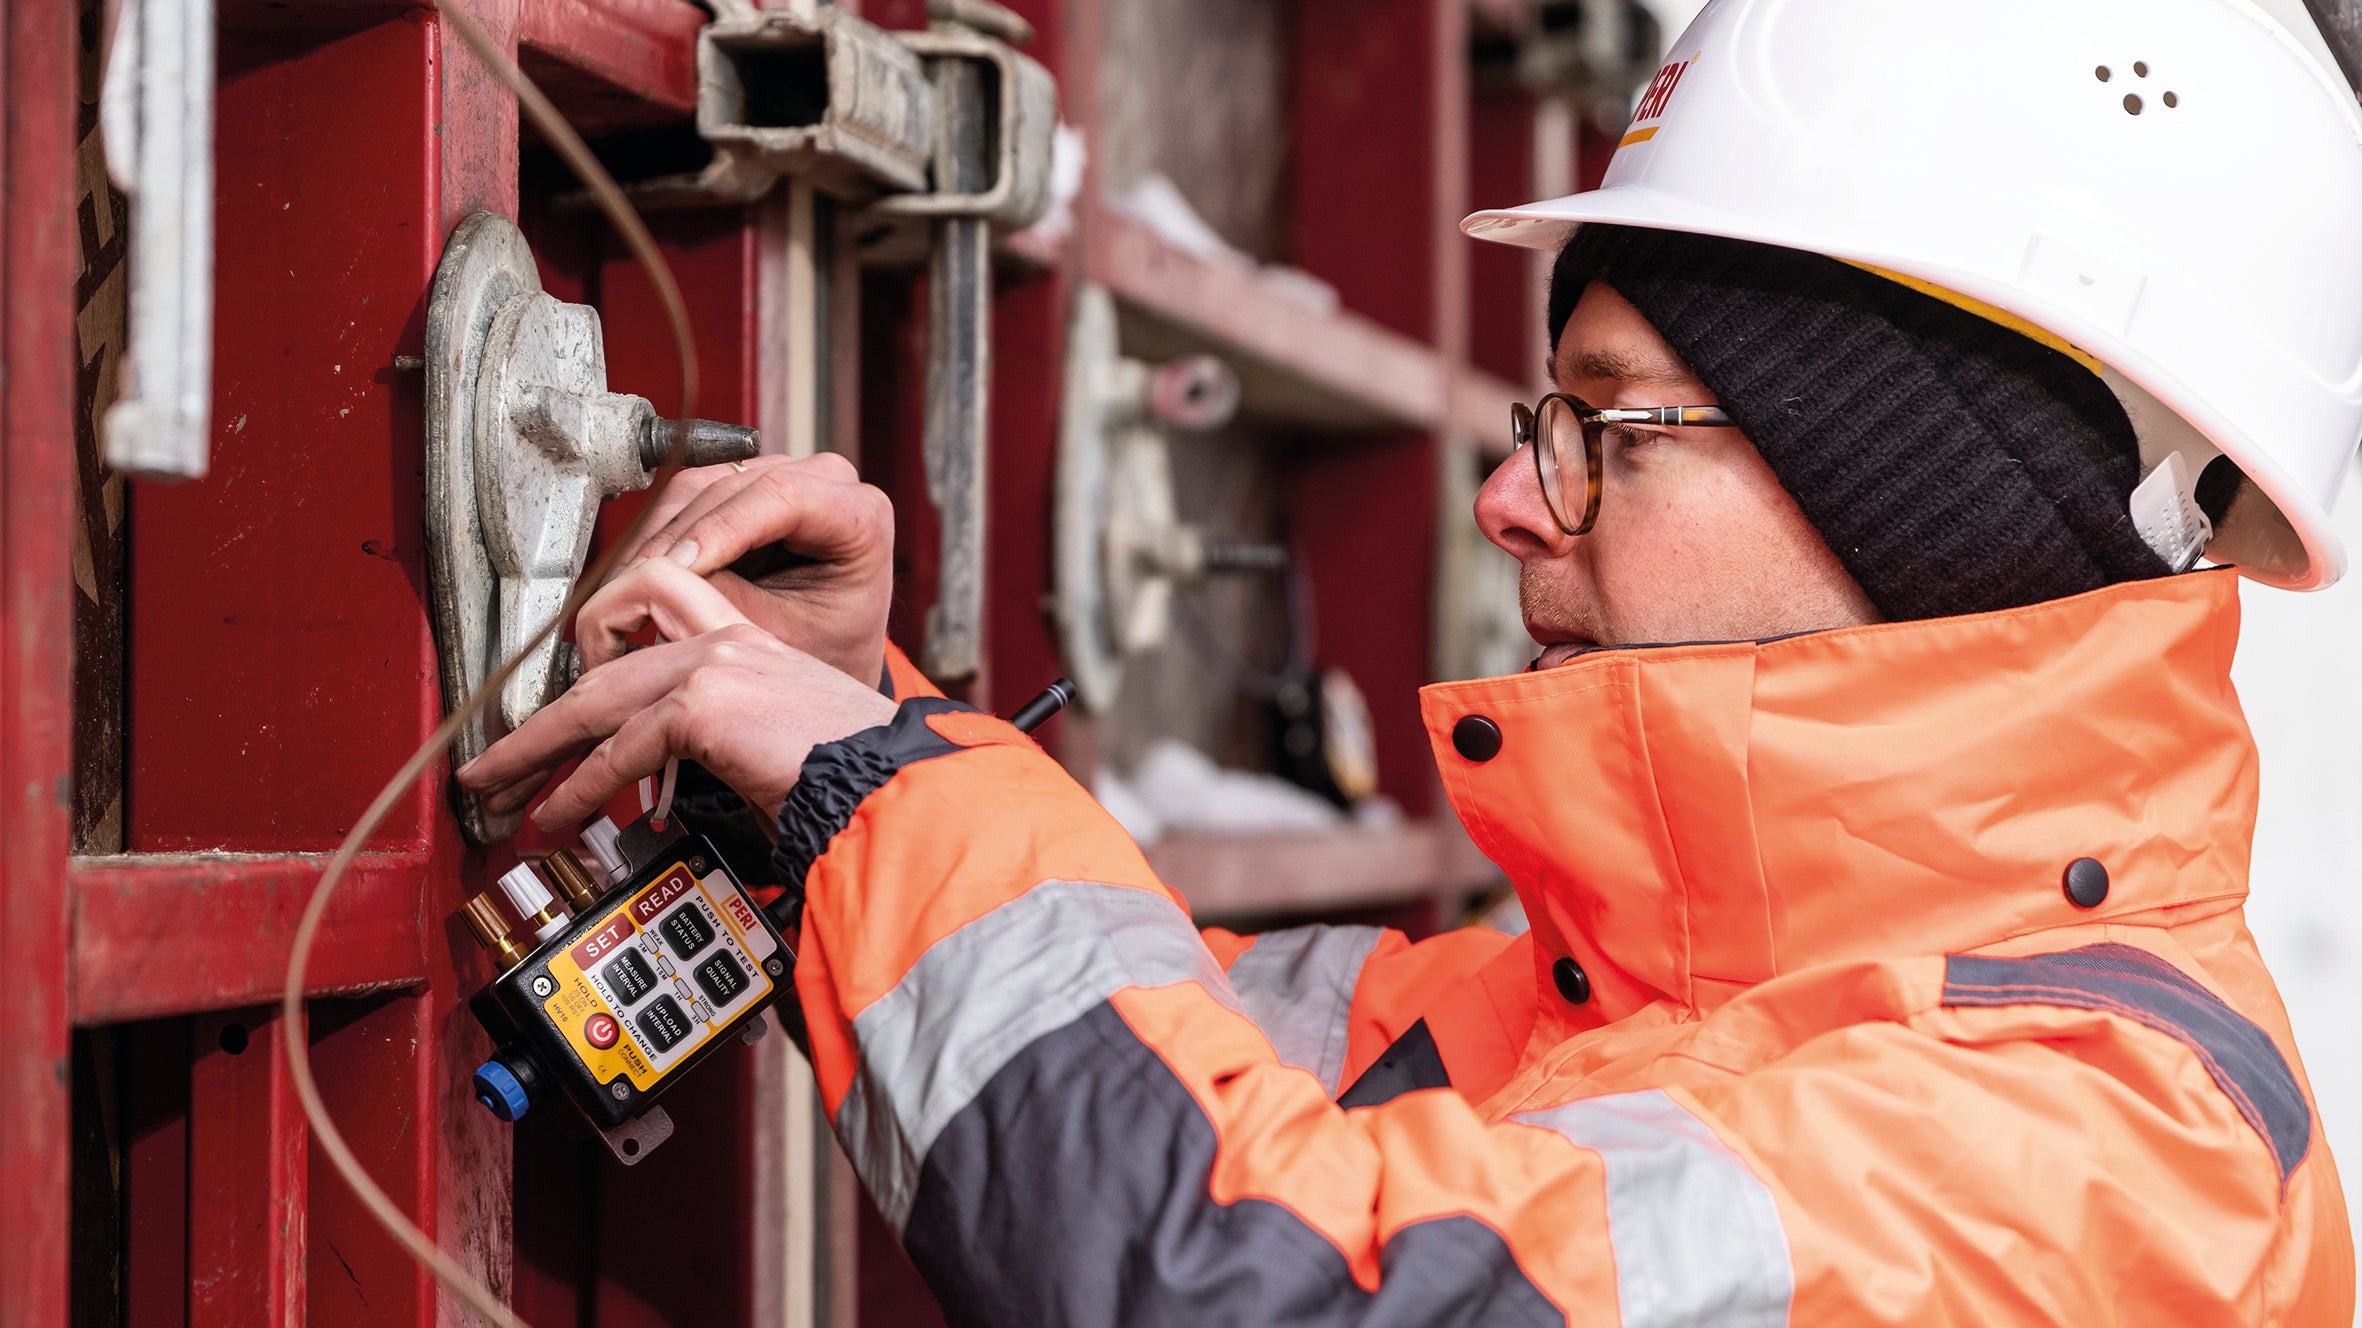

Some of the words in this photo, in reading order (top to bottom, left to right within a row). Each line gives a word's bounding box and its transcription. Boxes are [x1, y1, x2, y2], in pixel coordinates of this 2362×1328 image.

[637, 875, 685, 916] READ
[677, 911, 704, 944] BATTERY
[727, 897, 758, 931] PERI
[583, 924, 622, 958] SET
[637, 942, 647, 953] 5M
[648, 928, 664, 946] WEAK
[669, 918, 695, 950] STATUS
[694, 895, 721, 928] PUSH
[720, 929, 735, 947] TO
[733, 948, 759, 979] TEST
[611, 962, 638, 997] INTERVAL
[619, 955, 647, 990] MEASURE
[655, 966, 668, 981] 15M
[704, 965, 730, 996] QUALITY
[713, 959, 738, 989] SIGNAL
[573, 977, 598, 1008] HOLD
[697, 994, 716, 1017] STRONG
[590, 974, 614, 1003] HOLD
[611, 1003, 625, 1019] TO
[622, 1018, 657, 1062] CHANGE
[645, 1009, 673, 1044] INTERVAL
[654, 1002, 682, 1037] UPLOAD
[690, 1014, 700, 1025] 3H
[617, 1048, 641, 1079] CONNECT
[622, 1043, 647, 1074] PUSH
